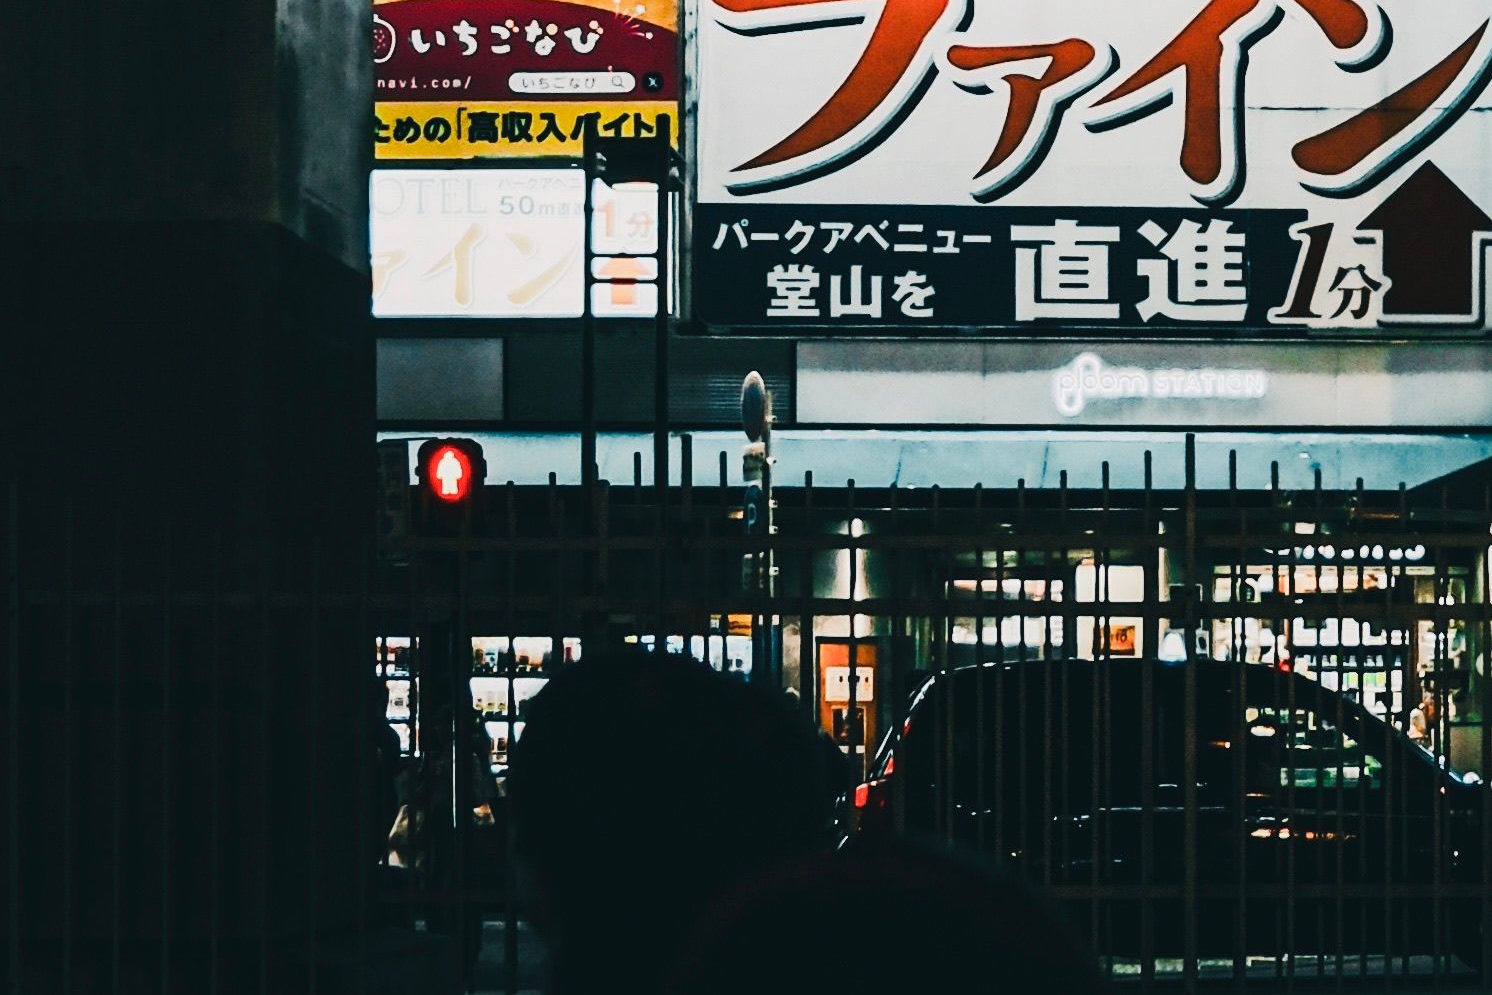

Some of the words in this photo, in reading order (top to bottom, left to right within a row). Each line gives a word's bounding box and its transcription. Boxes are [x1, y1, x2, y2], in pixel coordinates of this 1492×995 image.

[411, 19, 605, 56] いちごなび
[373, 178, 487, 216] OTEL
[712, 220, 992, 254] パークアベニュー
[1010, 219, 1249, 323] 直進
[1274, 221, 1380, 319] 1分
[766, 264, 937, 317] 堂山を
[1152, 371, 1264, 394] STATION
